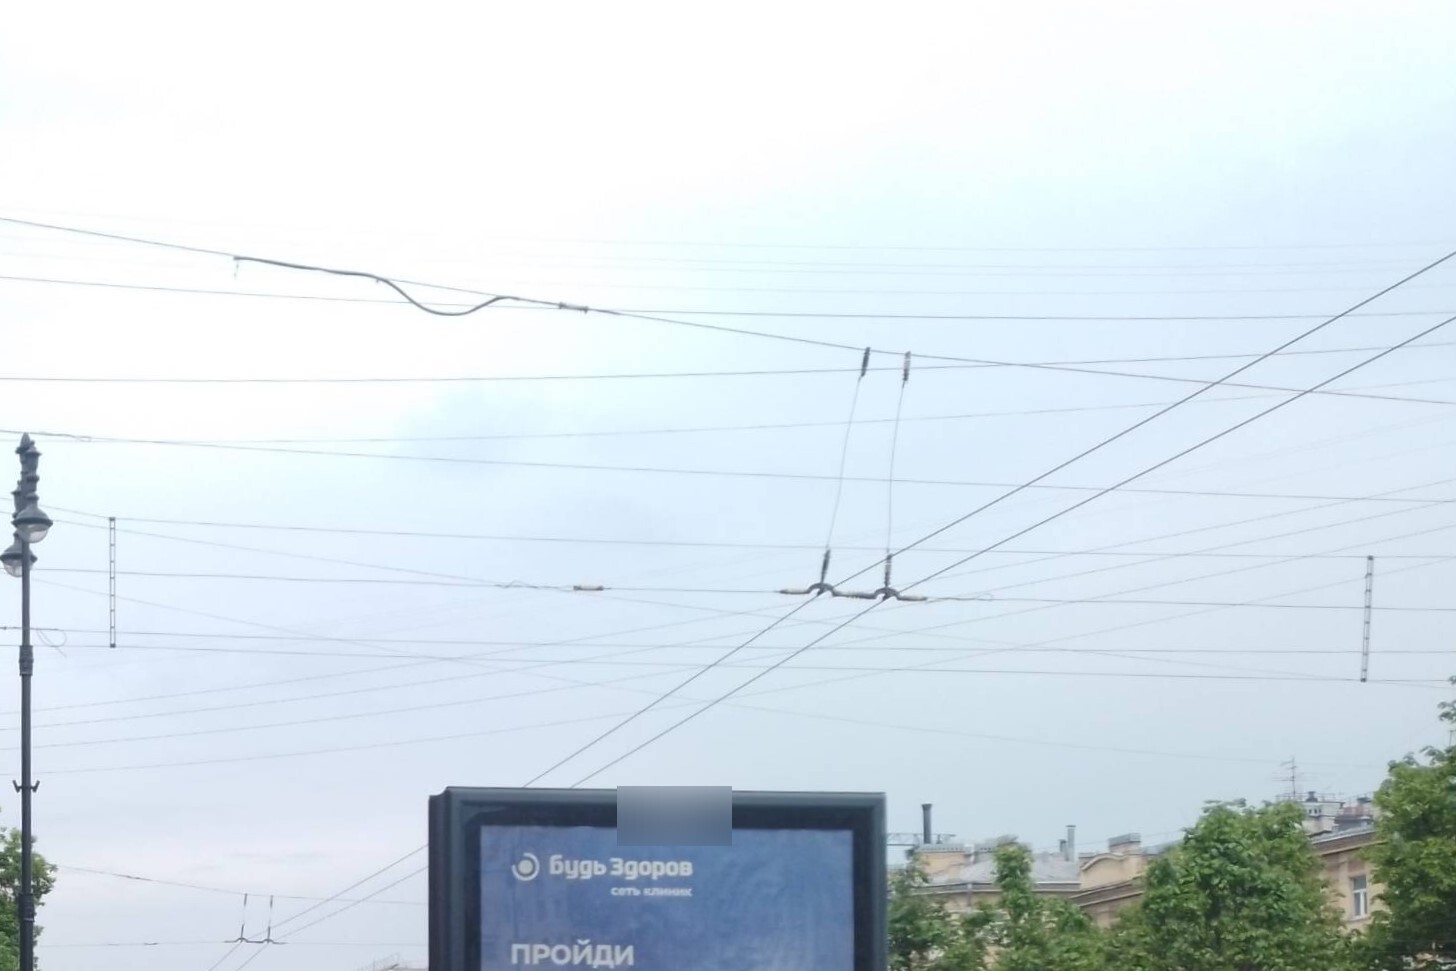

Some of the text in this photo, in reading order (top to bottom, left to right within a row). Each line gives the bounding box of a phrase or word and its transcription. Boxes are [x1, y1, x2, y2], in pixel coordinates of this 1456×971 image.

[611, 887, 693, 897] сеть клиник
[510, 939, 635, 968] ПРОЙДИ
